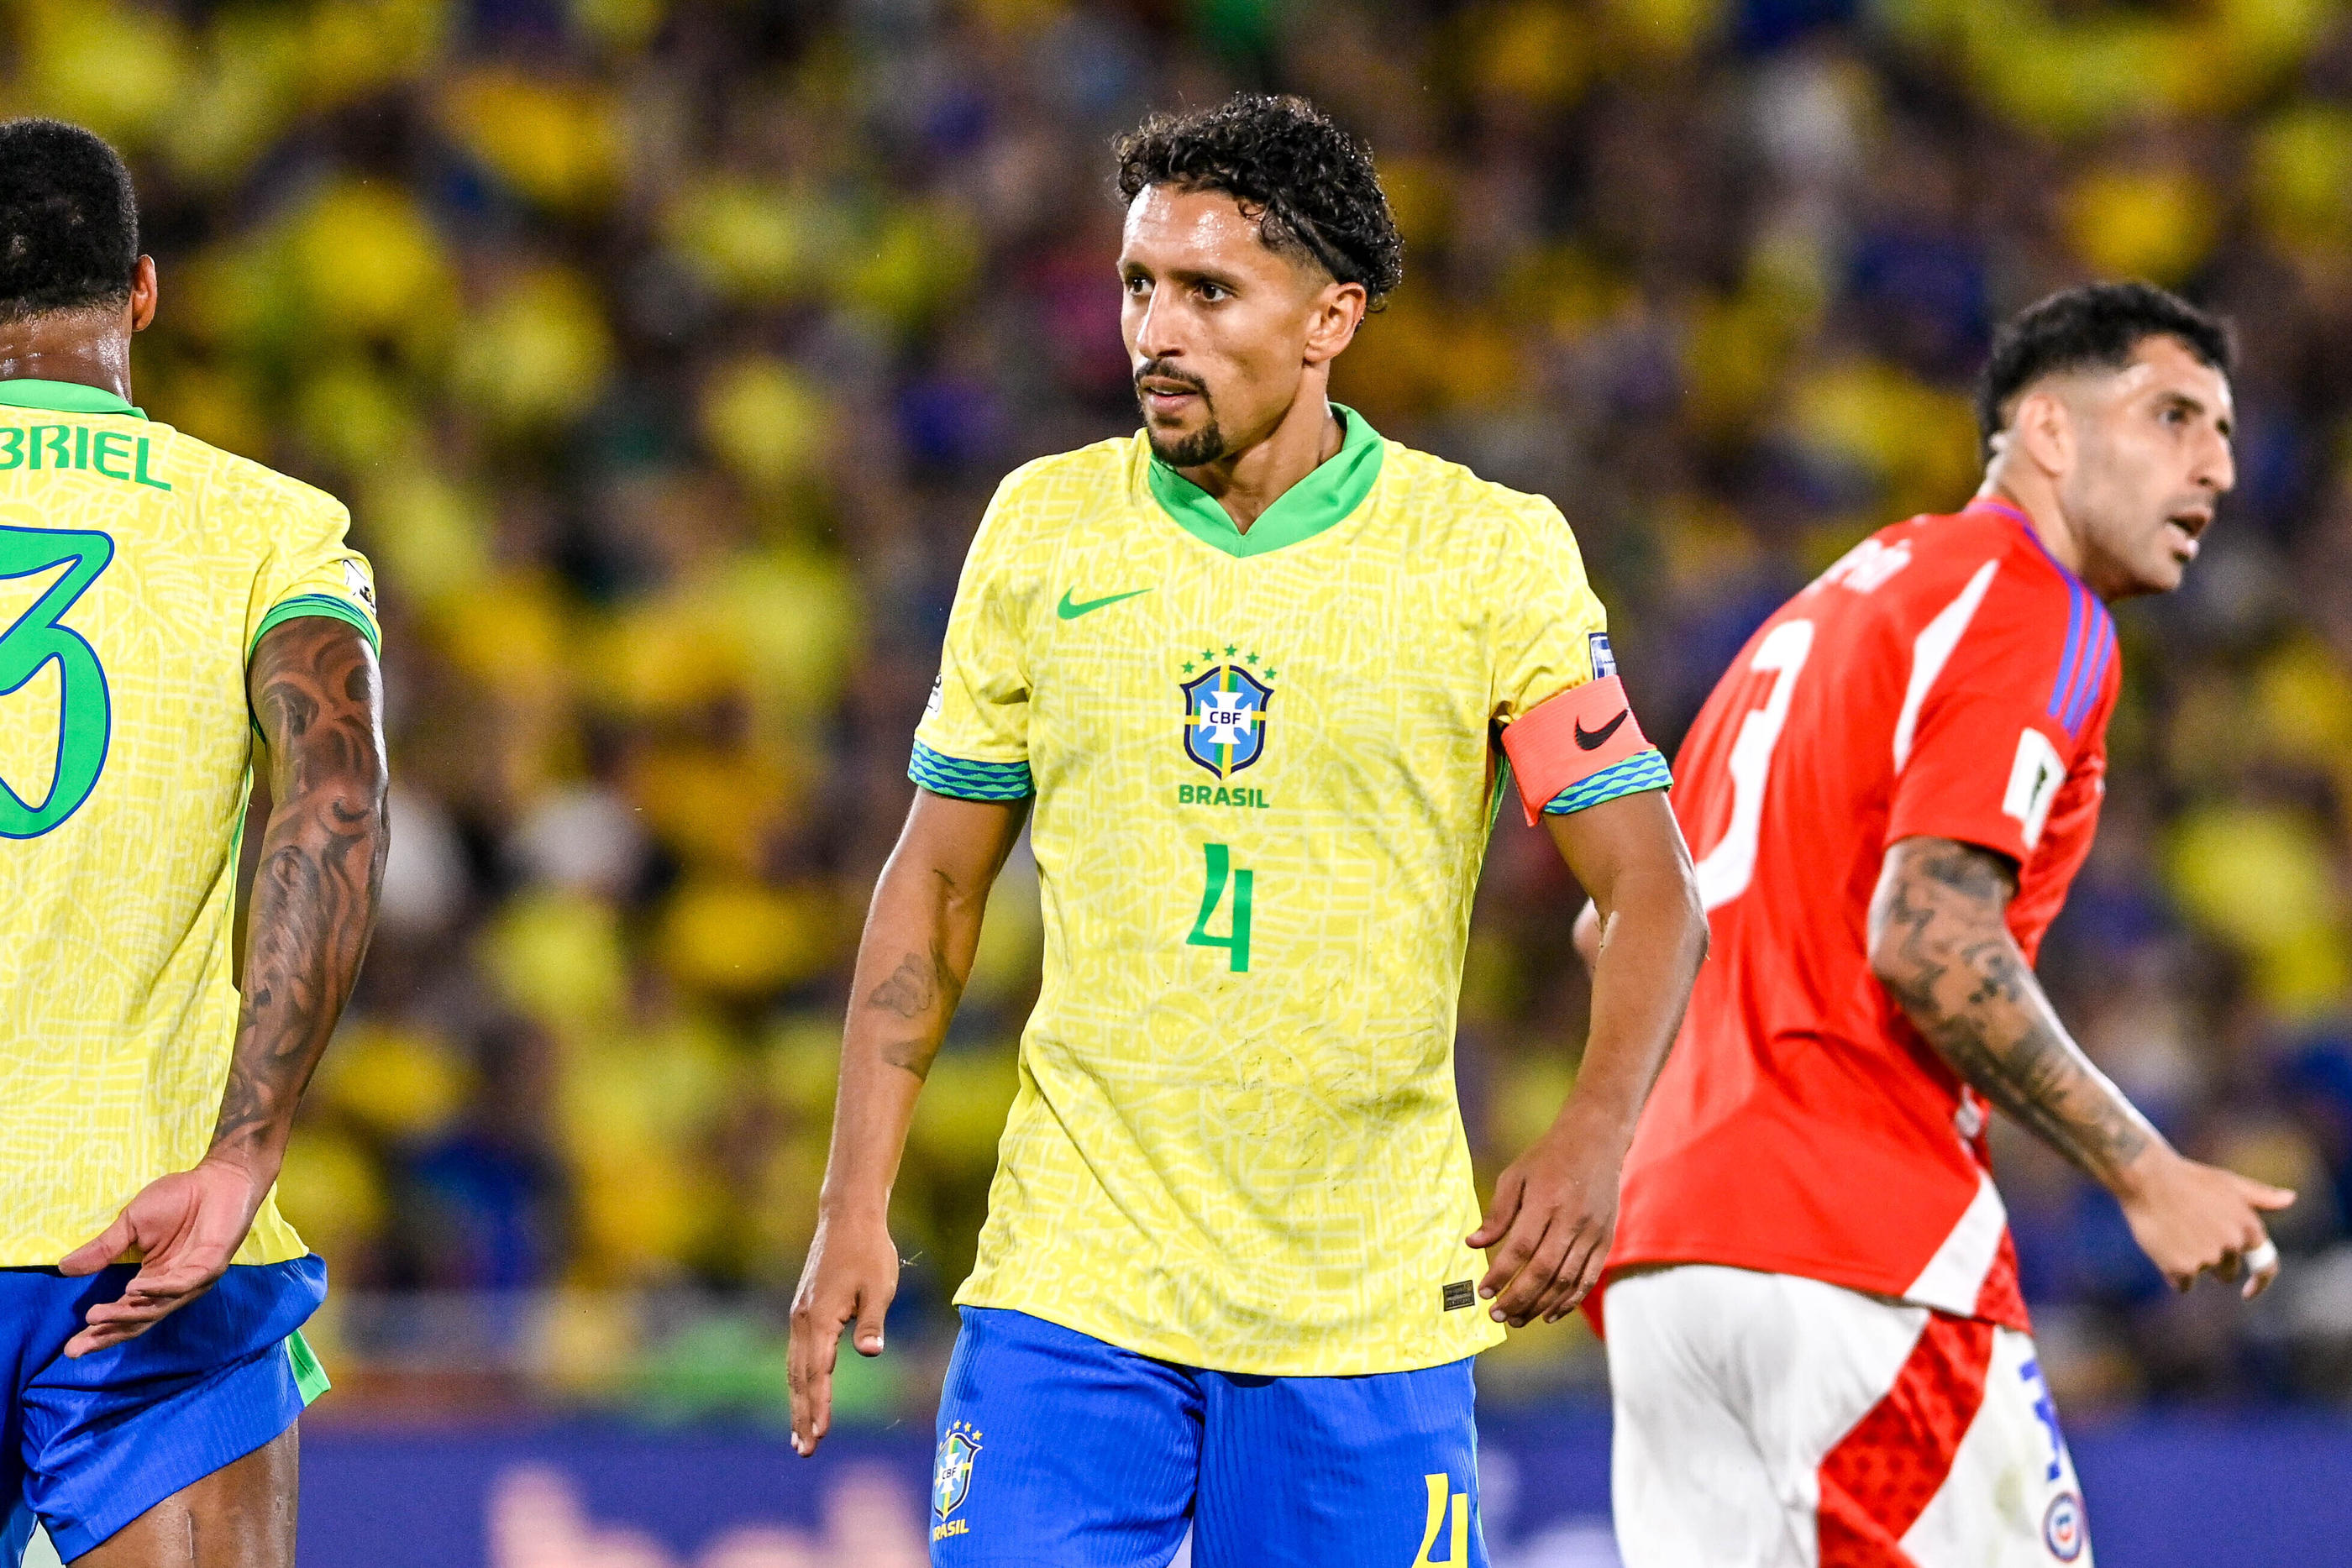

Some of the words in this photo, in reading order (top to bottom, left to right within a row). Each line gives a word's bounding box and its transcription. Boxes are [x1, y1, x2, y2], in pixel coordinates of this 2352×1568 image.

[0, 525, 114, 839] 3
[1210, 711, 1242, 725] CBF
[1694, 619, 1814, 912] 3
[1179, 784, 1270, 809] BRASIL
[1186, 843, 1253, 973] 4
[942, 1467, 957, 1480] CBF
[932, 1518, 969, 1542] RASIL
[1411, 1472, 1468, 1568] 4
